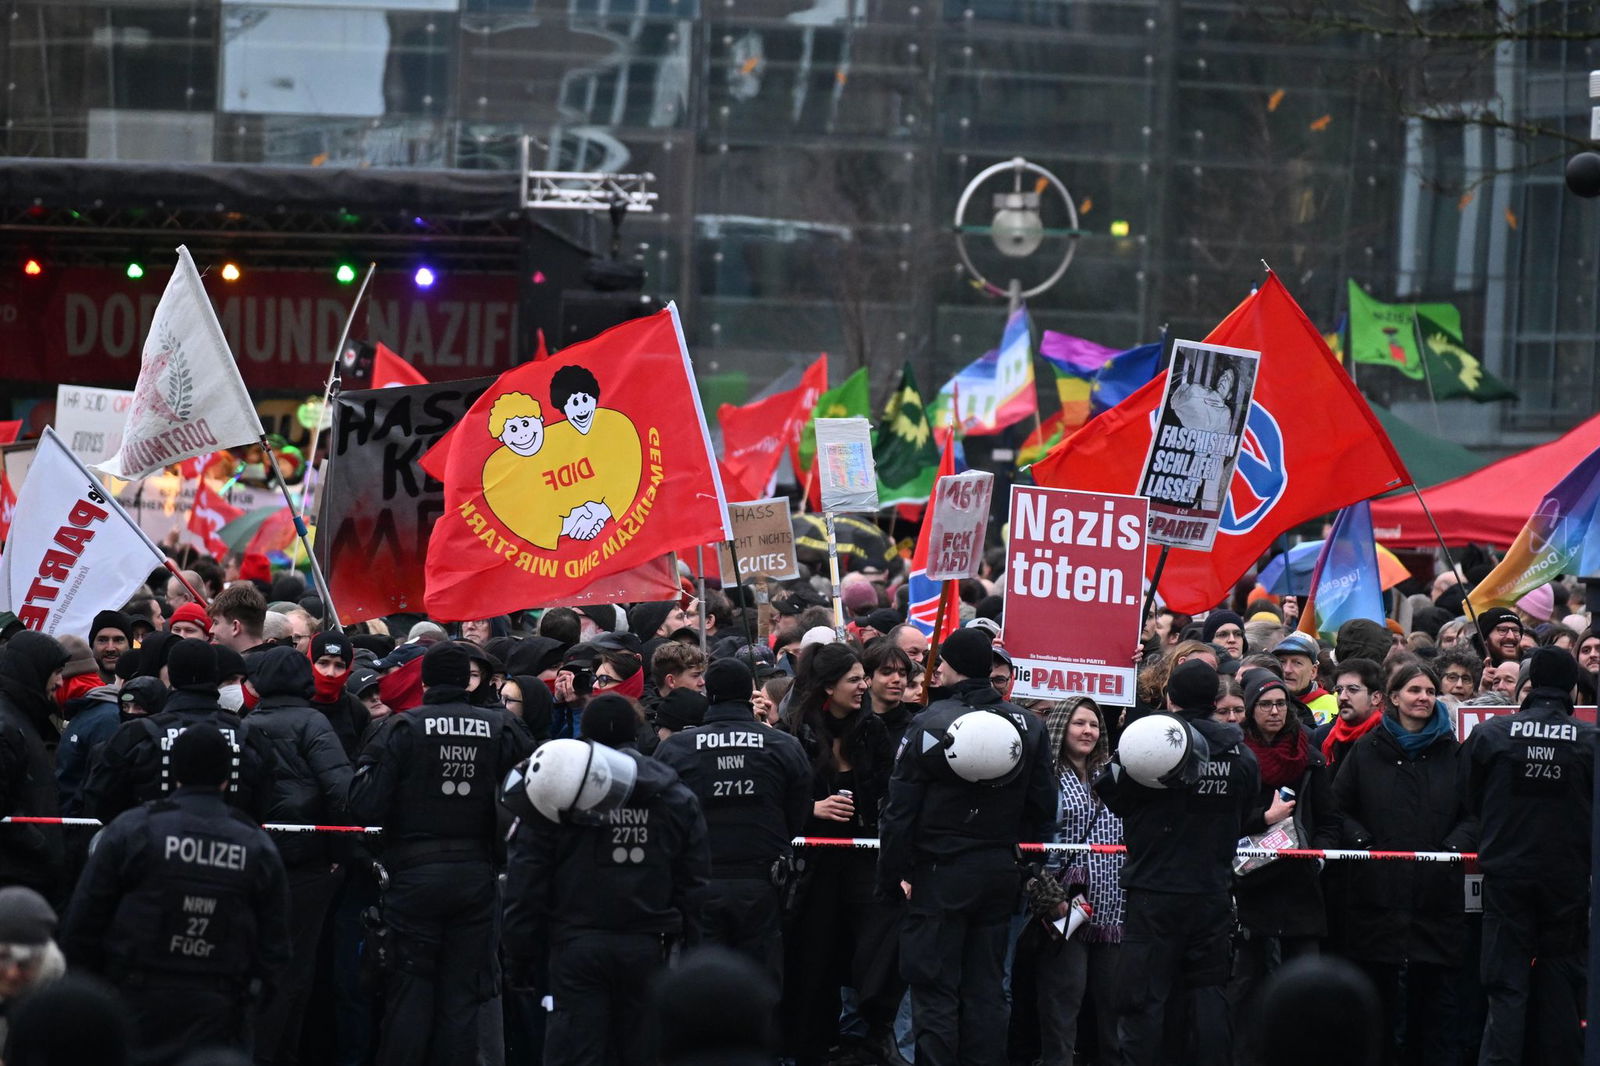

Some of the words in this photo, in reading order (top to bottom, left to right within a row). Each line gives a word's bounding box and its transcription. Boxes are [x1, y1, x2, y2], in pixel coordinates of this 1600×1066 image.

[337, 386, 490, 457] HAS
[1159, 424, 1238, 458] FASCHISTEN
[1152, 450, 1221, 480] SCHLAFEN
[1145, 474, 1201, 503] LASSEN
[735, 505, 775, 522] HASS
[1014, 492, 1141, 551] Nazis
[1151, 515, 1209, 541] PARTEI
[759, 531, 792, 547] NICHTS
[943, 531, 972, 551] FCK
[737, 553, 787, 574] GUTES
[941, 551, 969, 572] AFD
[1012, 548, 1136, 606] töten.
[1031, 667, 1124, 698] PARTEI
[425, 717, 491, 738] POLIZEI
[1510, 721, 1577, 741] POLIZEI
[696, 731, 764, 750] POLIZEI
[440, 745, 477, 762] NRW
[717, 755, 745, 770] NRW
[1527, 746, 1556, 761] NRW
[442, 762, 475, 778] 2713
[1198, 761, 1231, 776] NRW
[1525, 763, 1562, 779] 2743
[713, 779, 755, 796] 2712
[1198, 780, 1228, 795] 2712
[609, 808, 649, 825] NRW
[612, 827, 648, 844] 2713
[165, 836, 247, 870] POLIZEI
[183, 895, 217, 914] NRW
[186, 917, 209, 936] 27
